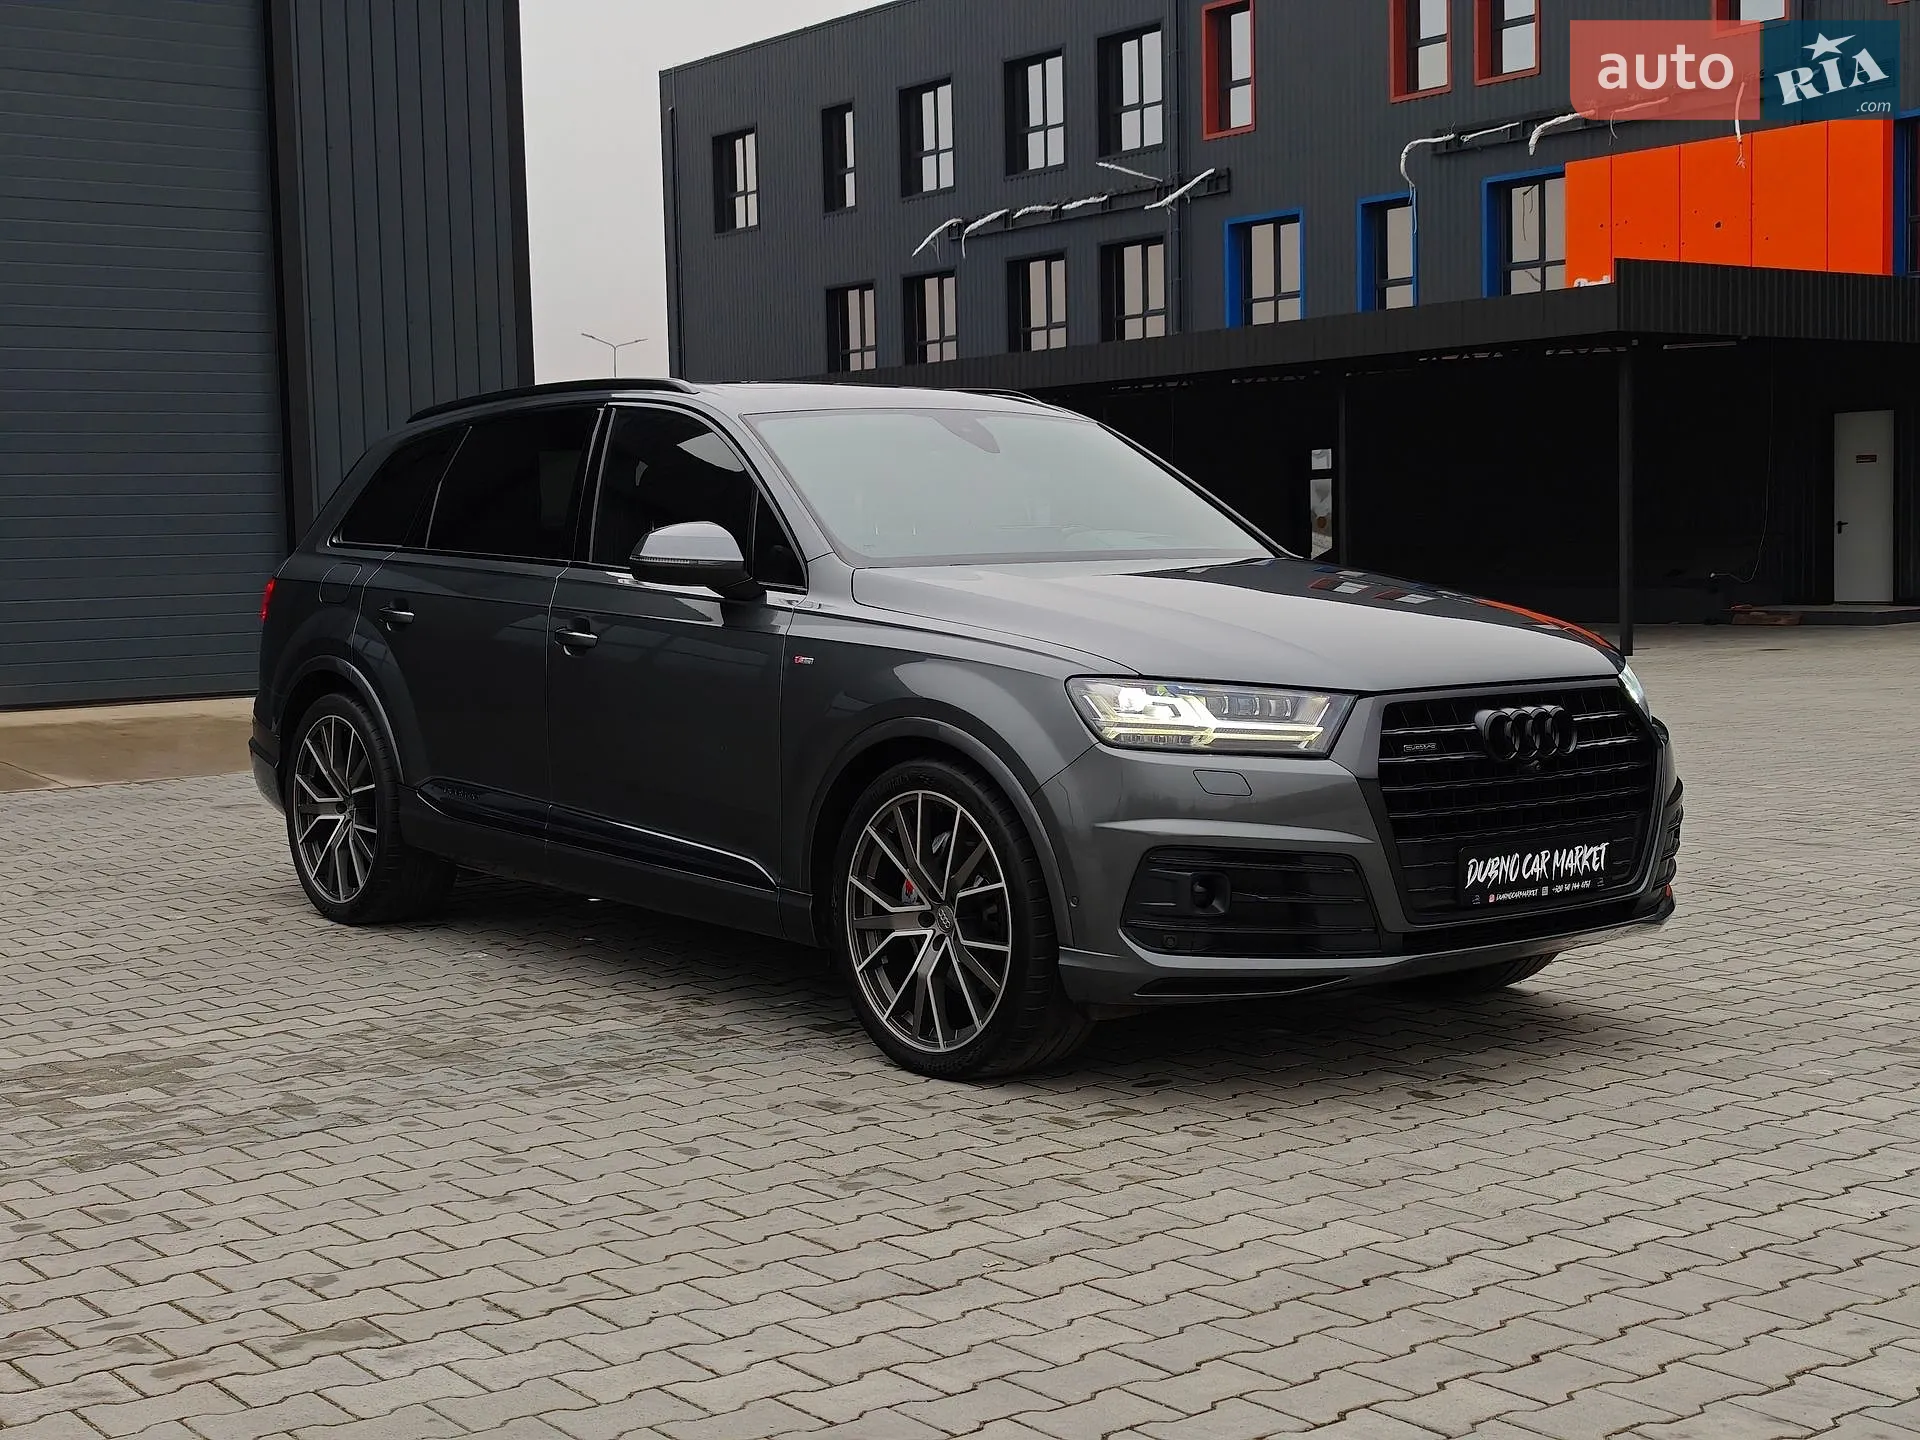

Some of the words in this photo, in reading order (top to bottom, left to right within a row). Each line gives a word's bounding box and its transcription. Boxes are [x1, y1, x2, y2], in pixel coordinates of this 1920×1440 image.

[1465, 853, 1520, 889] DUBNO
[1521, 850, 1551, 882] CAR
[1552, 842, 1610, 881] MARKET
